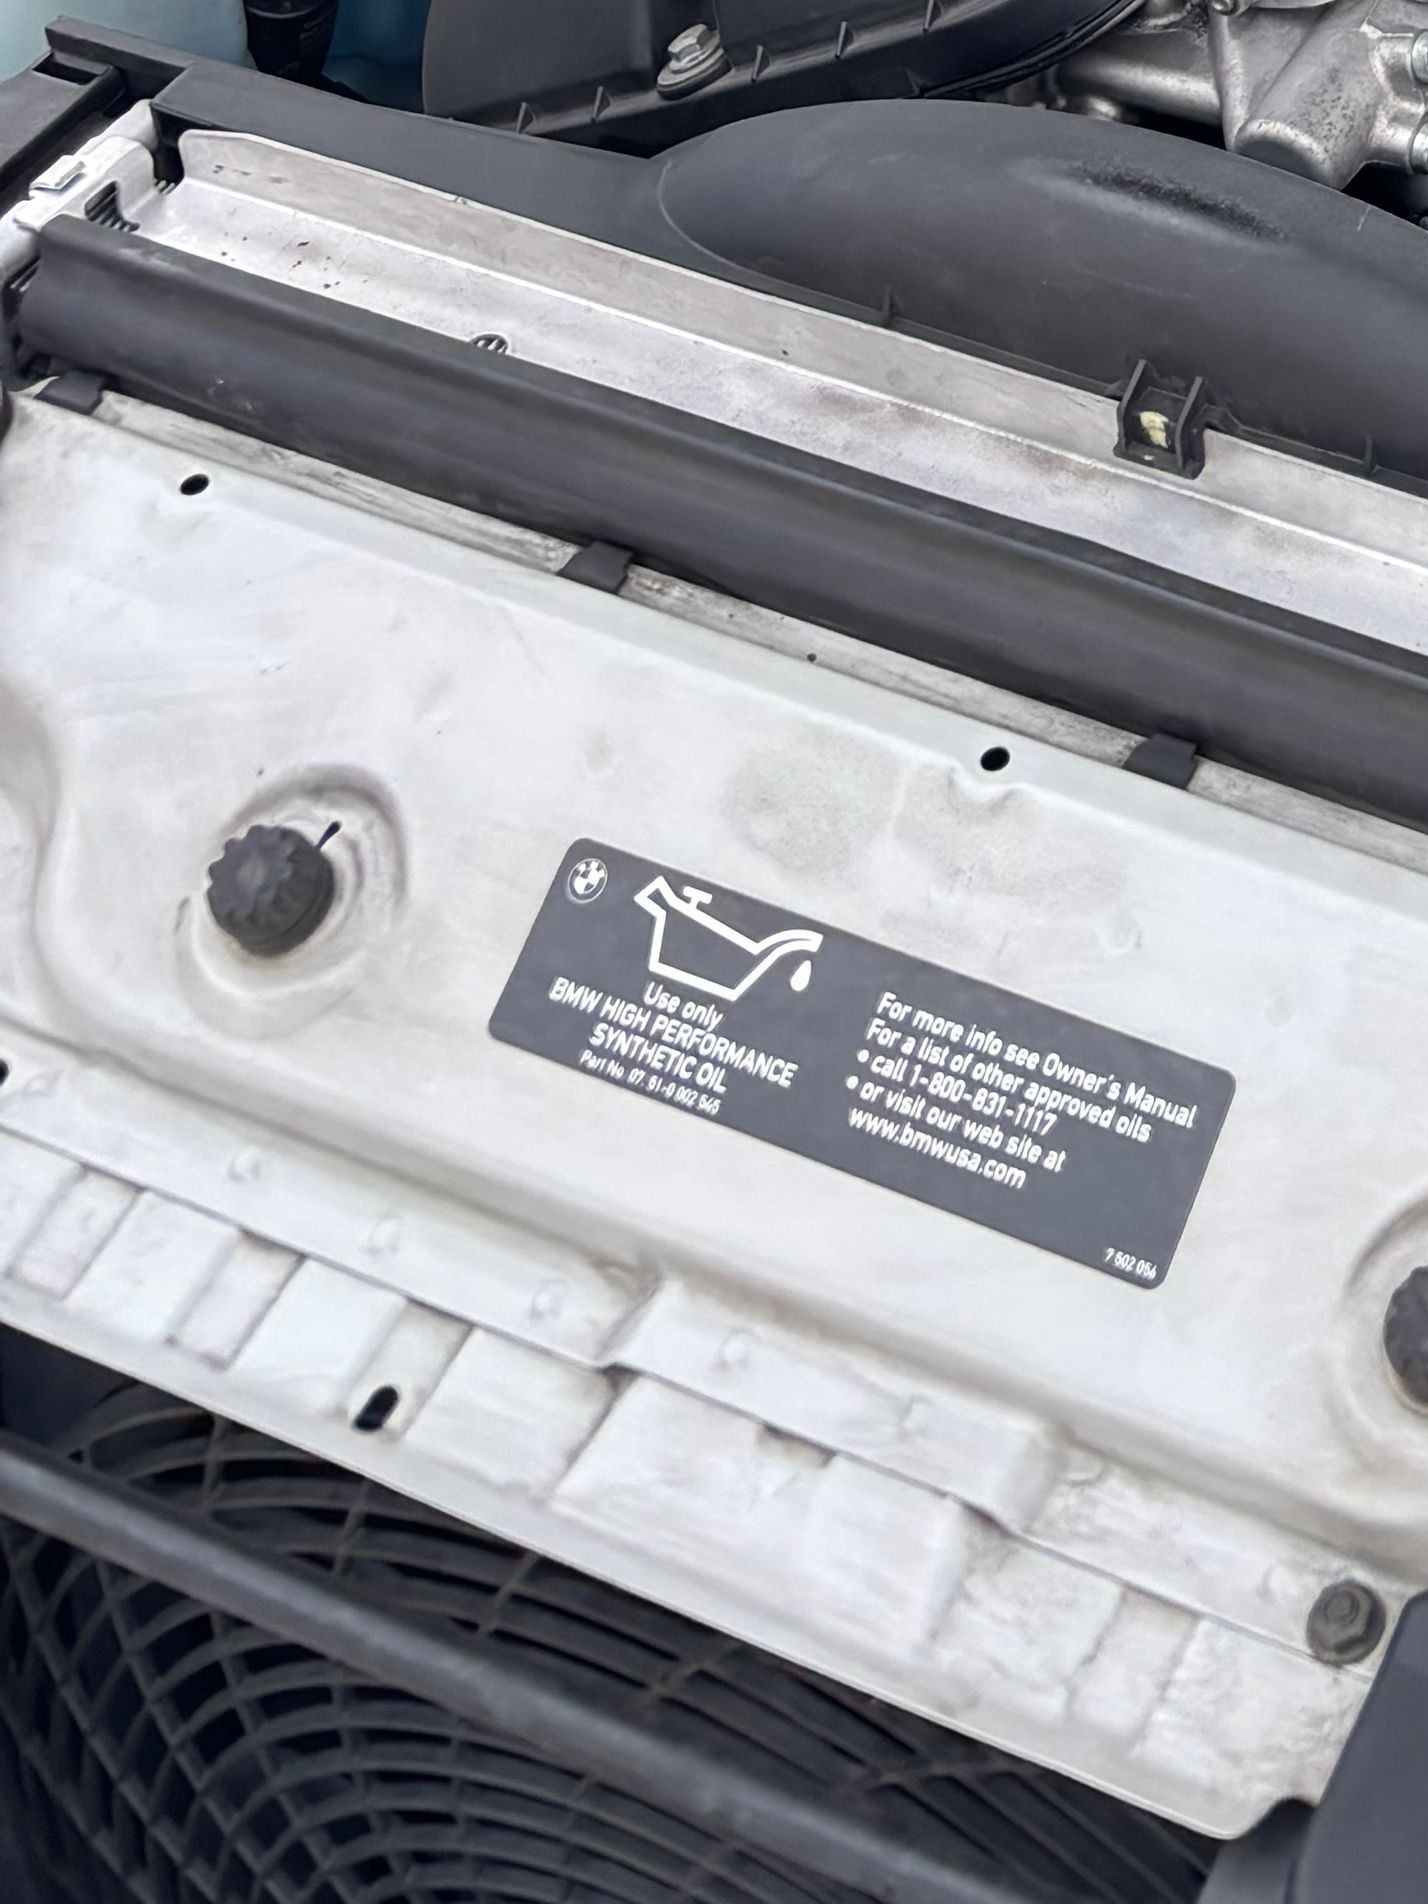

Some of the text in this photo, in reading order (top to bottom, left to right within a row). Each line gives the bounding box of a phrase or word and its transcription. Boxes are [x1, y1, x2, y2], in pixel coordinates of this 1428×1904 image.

[548, 977, 798, 1088] BMW HIGH PERFORMANCE
[643, 981, 724, 1035] Use only
[579, 1049, 607, 1072] Part
[589, 1022, 727, 1094] SYNTHETIC OIL
[866, 1017, 1152, 1143] For a list of other approved oils
[870, 1055, 1057, 1135] call 1-800-831-1117
[876, 991, 1198, 1129] For more info see Owner's Manual
[848, 1108, 1026, 1189] www.bmwusa.com
[859, 1081, 1067, 1173] or visit our web site at
